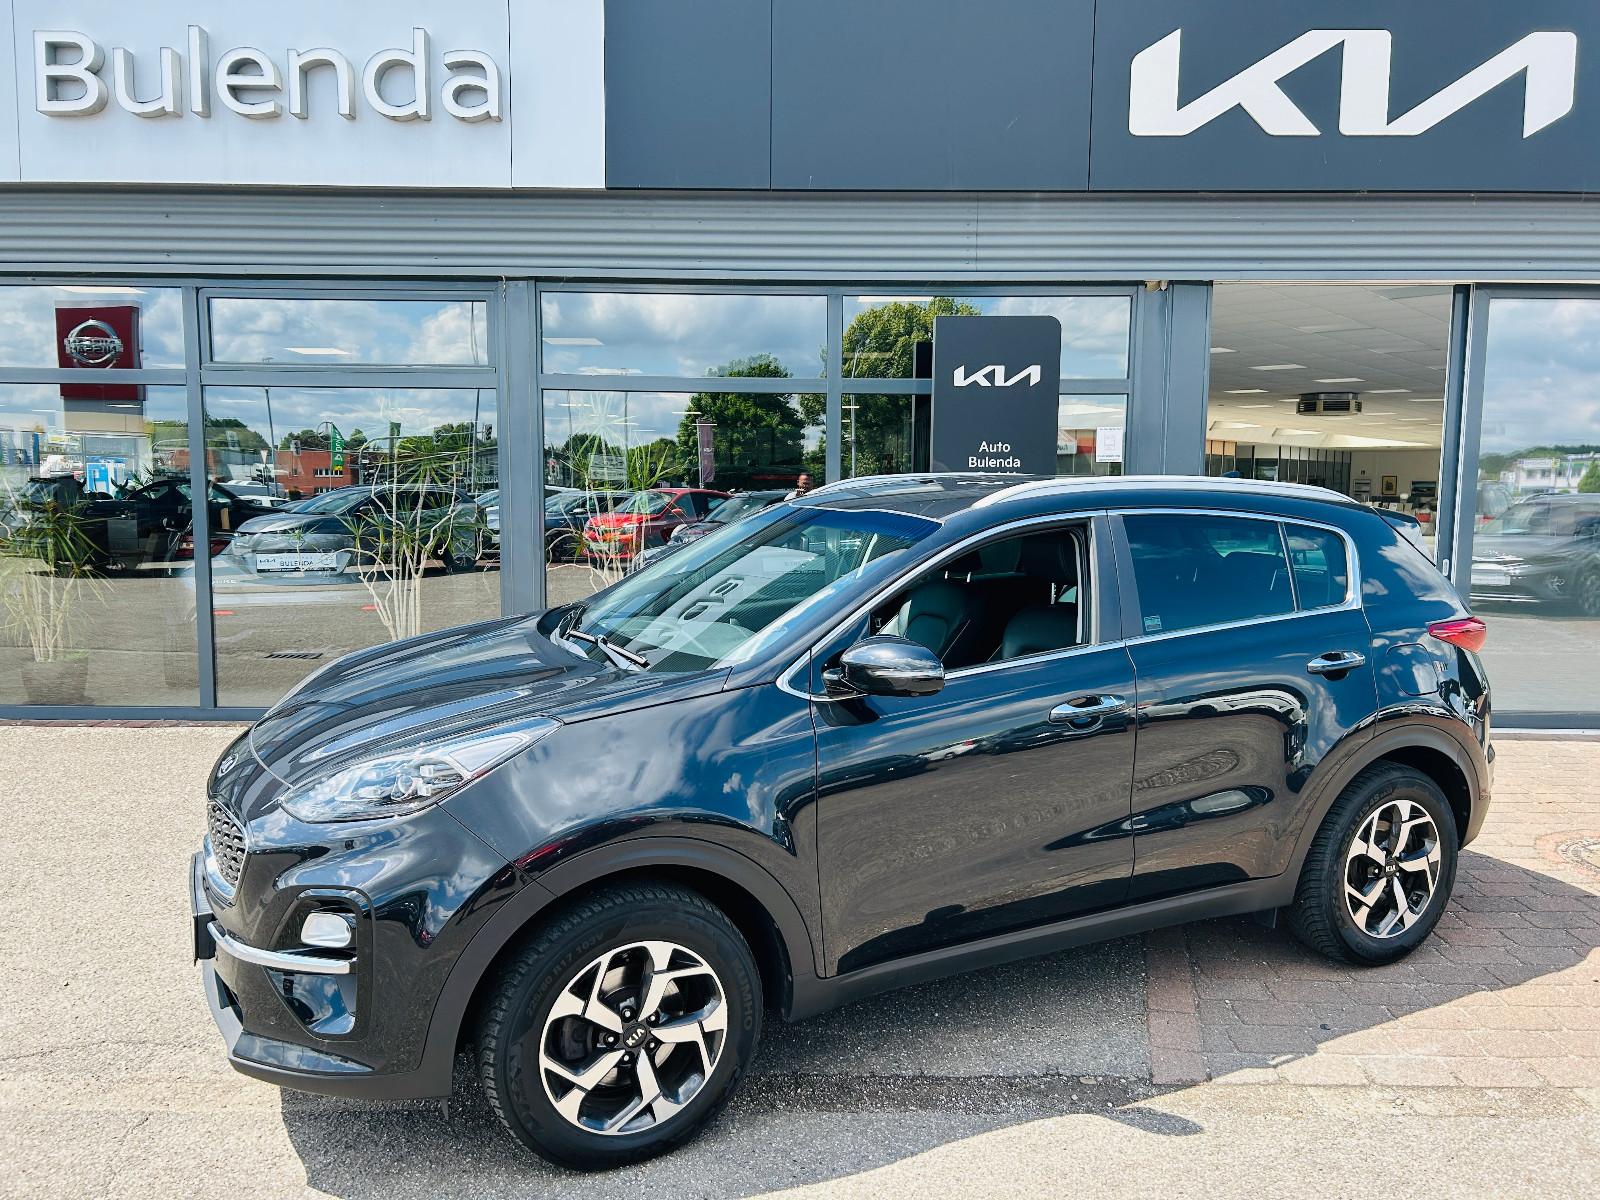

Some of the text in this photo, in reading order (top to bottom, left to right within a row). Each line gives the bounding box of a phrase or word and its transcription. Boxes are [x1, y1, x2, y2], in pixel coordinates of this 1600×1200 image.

[33, 25, 502, 122] Bulenda
[1129, 28, 1577, 139] KIA
[953, 364, 1041, 387] KIA
[979, 440, 1011, 453] Auto
[968, 455, 1021, 468] Bulenda
[625, 1028, 645, 1046] KIA
